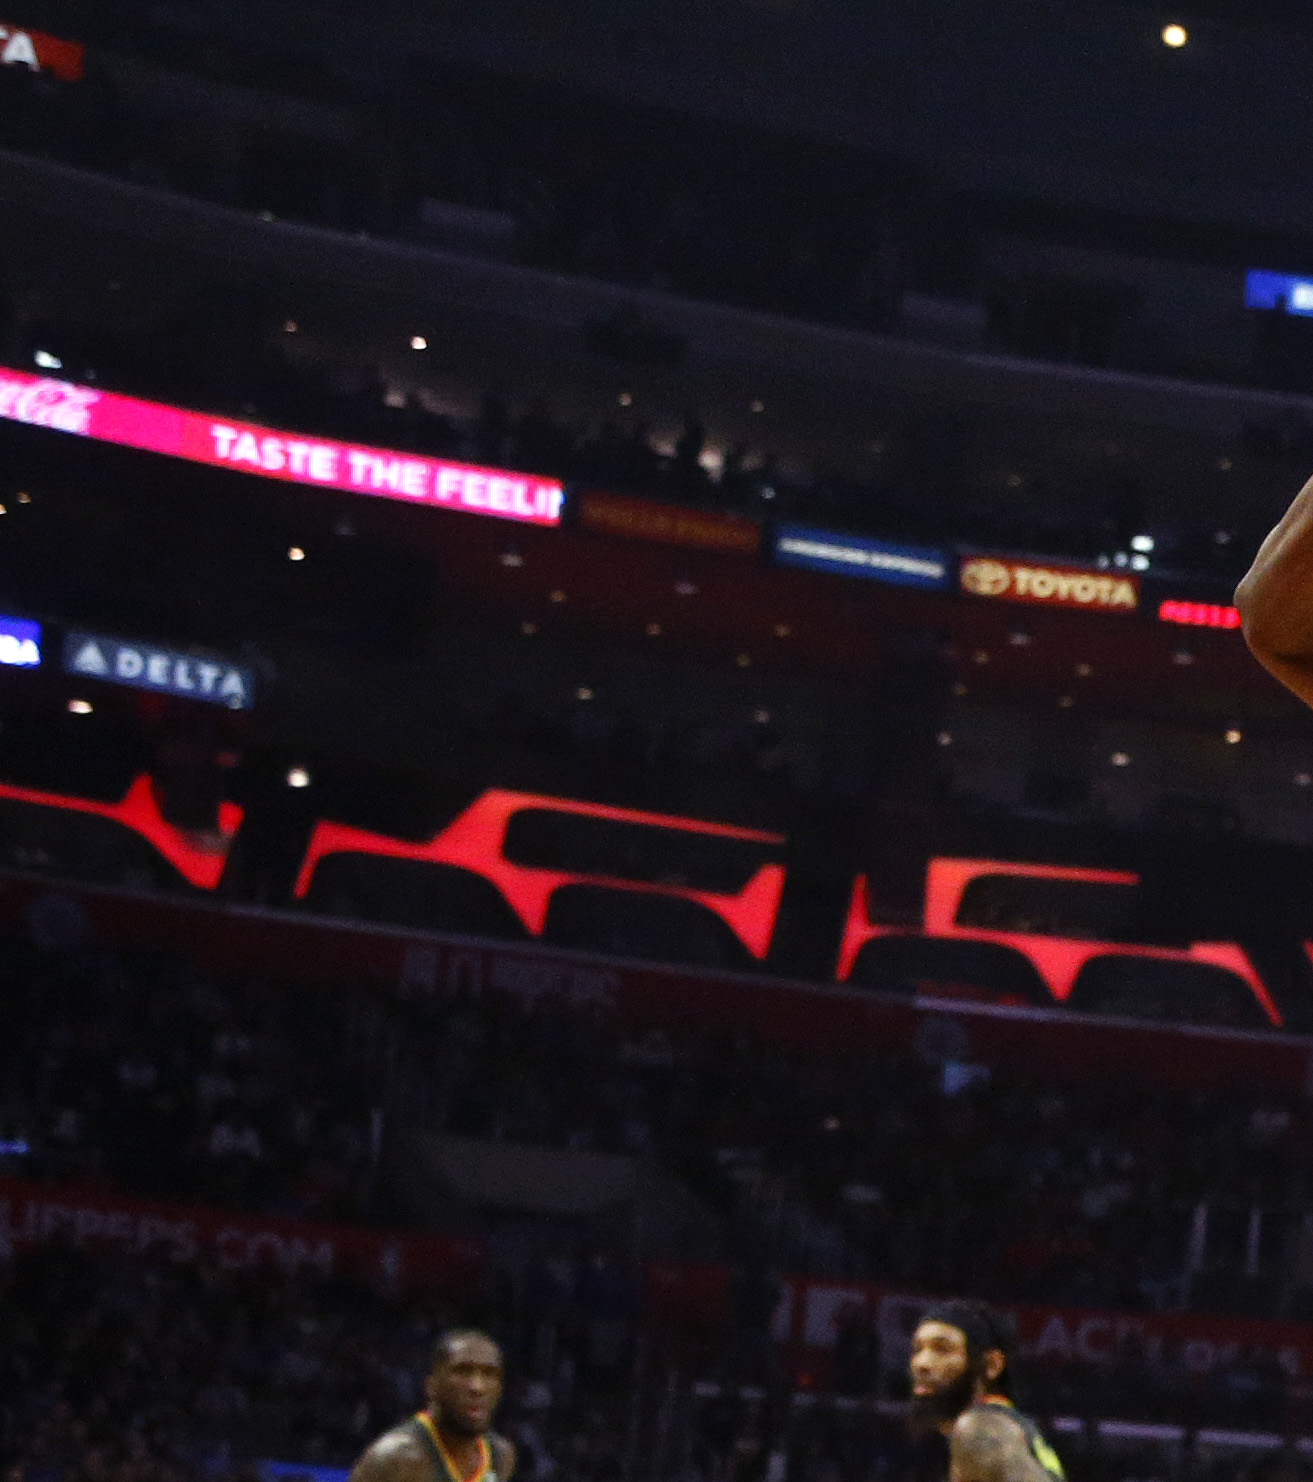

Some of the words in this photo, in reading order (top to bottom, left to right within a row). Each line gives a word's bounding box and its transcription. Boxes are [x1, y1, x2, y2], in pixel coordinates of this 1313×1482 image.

[211, 424, 340, 482] TASTE
[348, 451, 427, 498] THE
[1013, 565, 1139, 609] TOYOTA
[115, 646, 247, 698] DELTA
